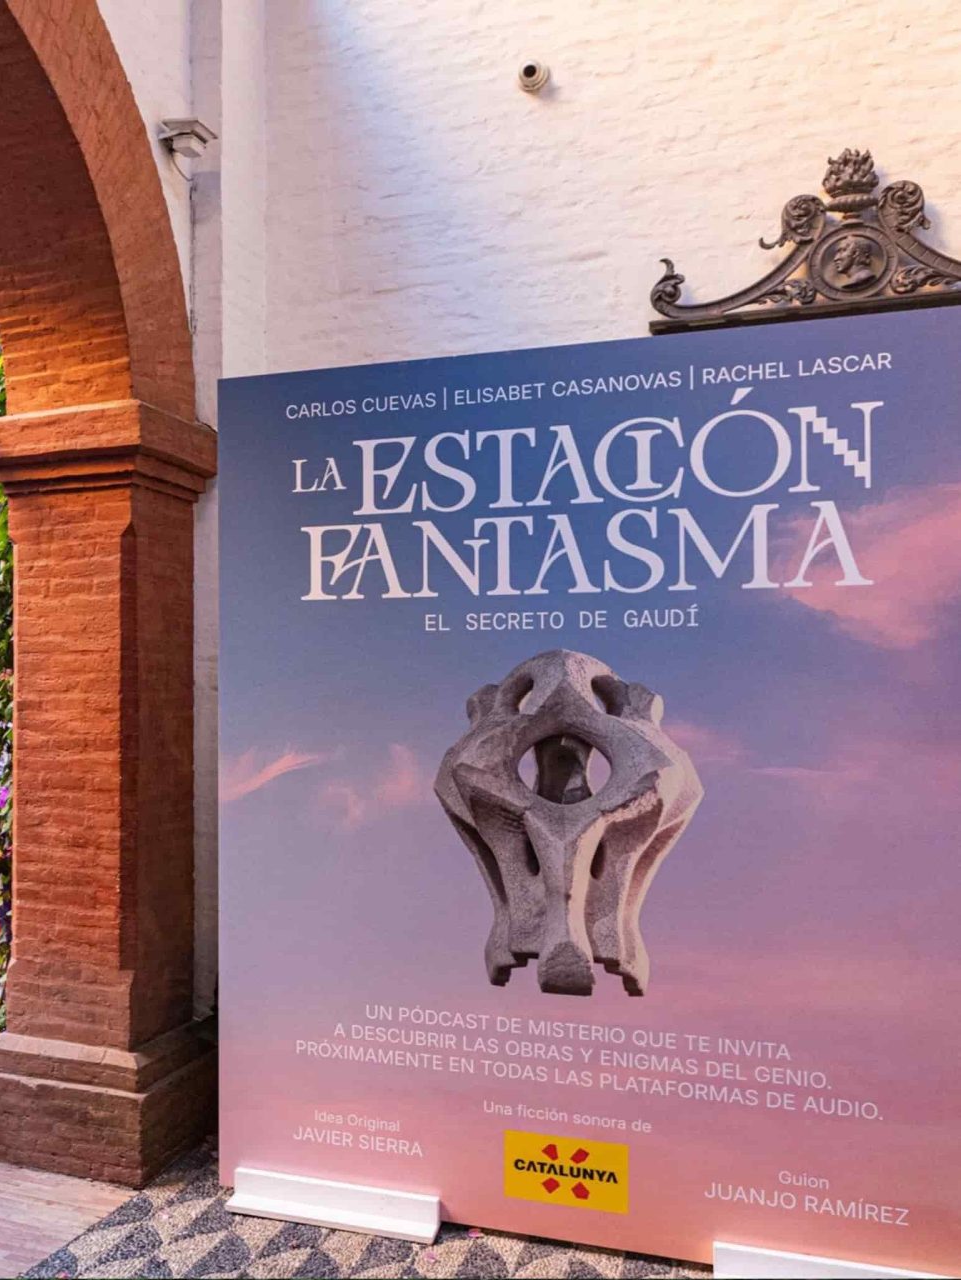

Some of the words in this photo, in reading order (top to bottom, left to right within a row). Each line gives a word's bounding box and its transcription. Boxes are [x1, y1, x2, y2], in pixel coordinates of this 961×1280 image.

[286, 399, 357, 419] CARLOS
[362, 392, 436, 412] CUEVAS
[454, 382, 546, 406] ELISABET
[552, 370, 682, 397] CASANOVAS
[702, 361, 790, 385] RACHEL
[798, 352, 892, 377] LASCAR
[291, 456, 347, 494] LA
[352, 387, 885, 515] ESTACIÓN
[301, 500, 874, 602] FANTASMA
[425, 614, 450, 631] EL
[465, 611, 565, 631] SECRETO
[579, 610, 608, 629] DE
[624, 603, 699, 628] GAUDÍ
[366, 1004, 393, 1021] UN
[496, 1016, 522, 1034] DE
[529, 1019, 626, 1044] MISTERIO
[632, 1029, 677, 1049] QUE
[684, 1034, 710, 1053] TE
[718, 1038, 792, 1061] INVITA
[333, 1022, 346, 1039] A
[351, 1024, 457, 1049] DESCUBRIR
[462, 1036, 499, 1054] LAS
[505, 1040, 573, 1062] OBRAS
[580, 1049, 593, 1063] Y
[600, 1050, 699, 1076] ENIGMAS
[706, 1060, 748, 1081] DEL
[755, 1066, 833, 1090] GENIO.
[295, 1040, 444, 1070] PRÓXIMAMENTE
[449, 1056, 475, 1074] EN
[481, 1059, 548, 1082] TODAS
[554, 1068, 594, 1088] LAS
[599, 1073, 759, 1107] PLATAFORMAS
[766, 1091, 797, 1111] DE
[803, 1096, 884, 1121] AUDIO.
[314, 1109, 343, 1125] Idea
[347, 1114, 400, 1133] Original
[483, 1100, 513, 1116] Una
[517, 1104, 569, 1123] ficción
[572, 1112, 628, 1131] sonora
[631, 1118, 652, 1134] de
[293, 1126, 353, 1149] JAVIER
[359, 1134, 423, 1158] SIERRA
[514, 1158, 619, 1184] CATALUNYA
[778, 1170, 830, 1190] Guion
[704, 1182, 798, 1210] JUANJO
[804, 1196, 910, 1227] RAMÍREZ
